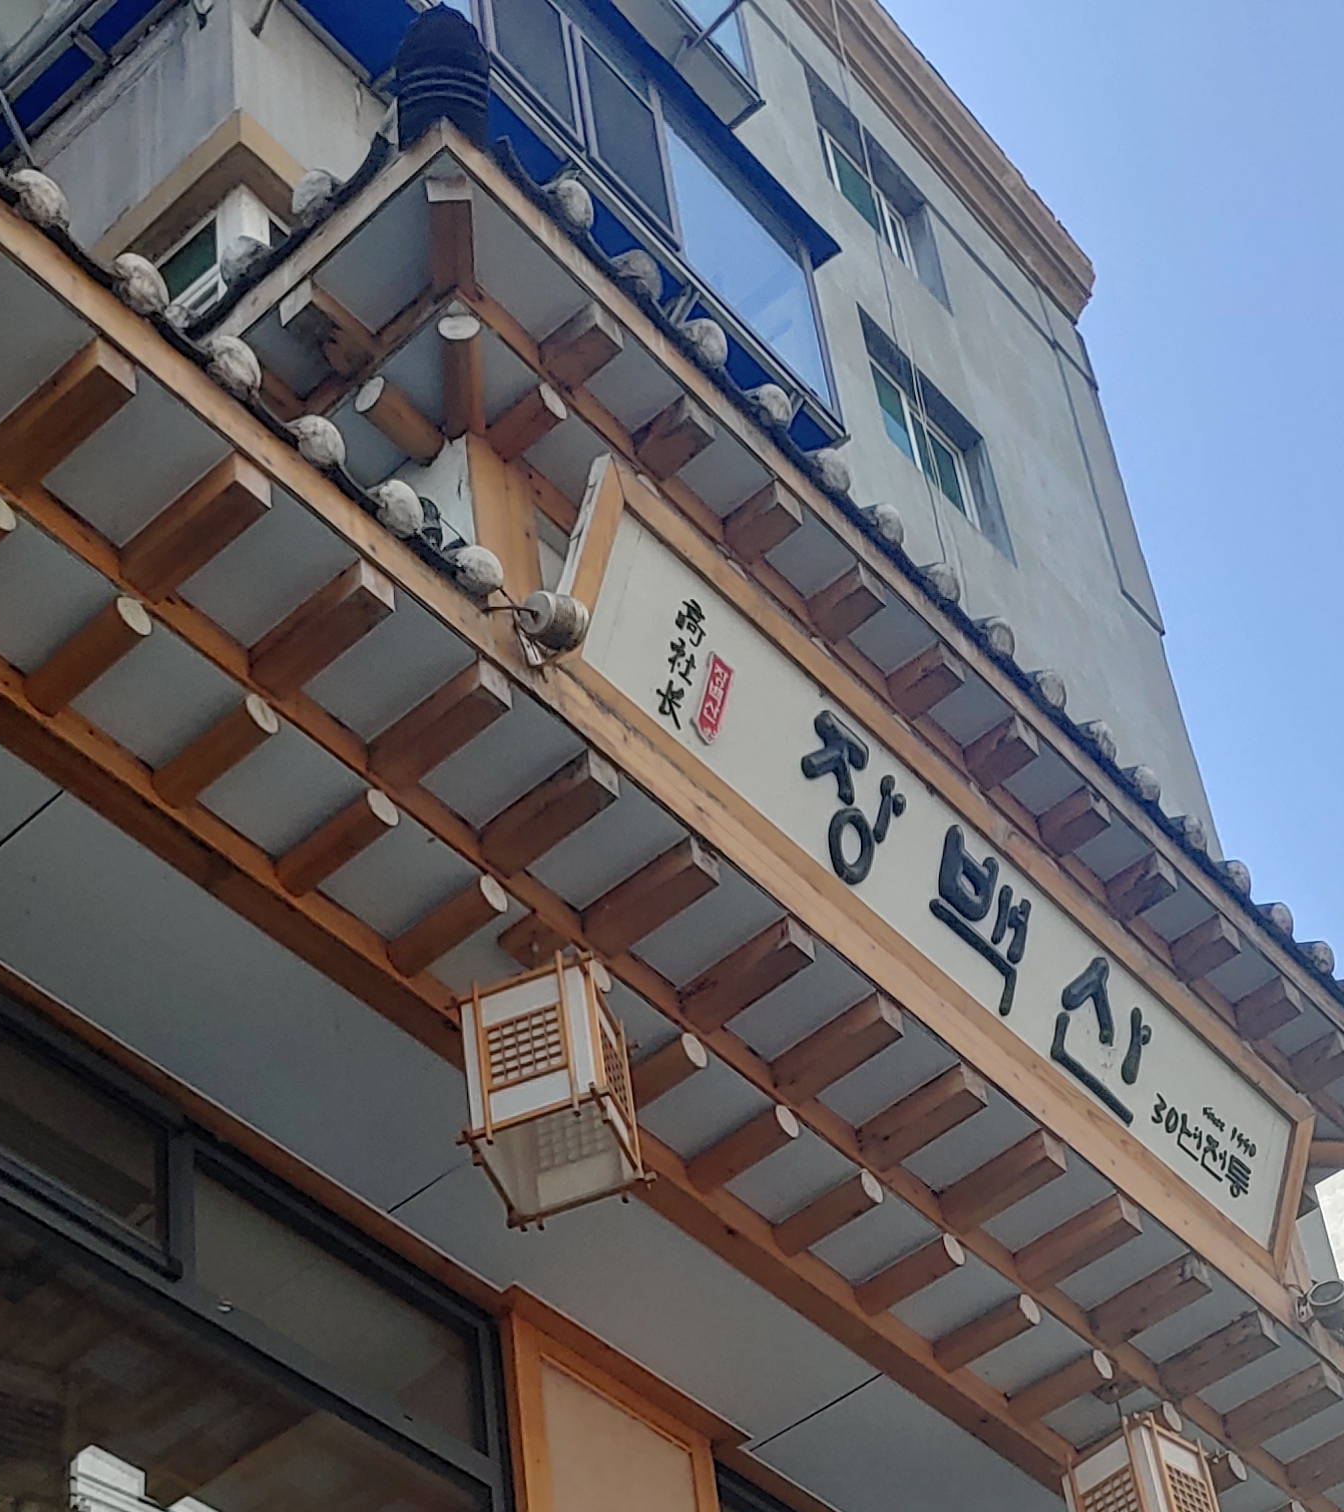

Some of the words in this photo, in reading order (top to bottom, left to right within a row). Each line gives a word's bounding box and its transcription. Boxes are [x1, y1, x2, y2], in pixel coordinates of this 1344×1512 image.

[801, 709, 1152, 1127] 장백산
[1151, 1092, 1252, 1198] 30년전통
[1229, 1126, 1257, 1158] 1990
